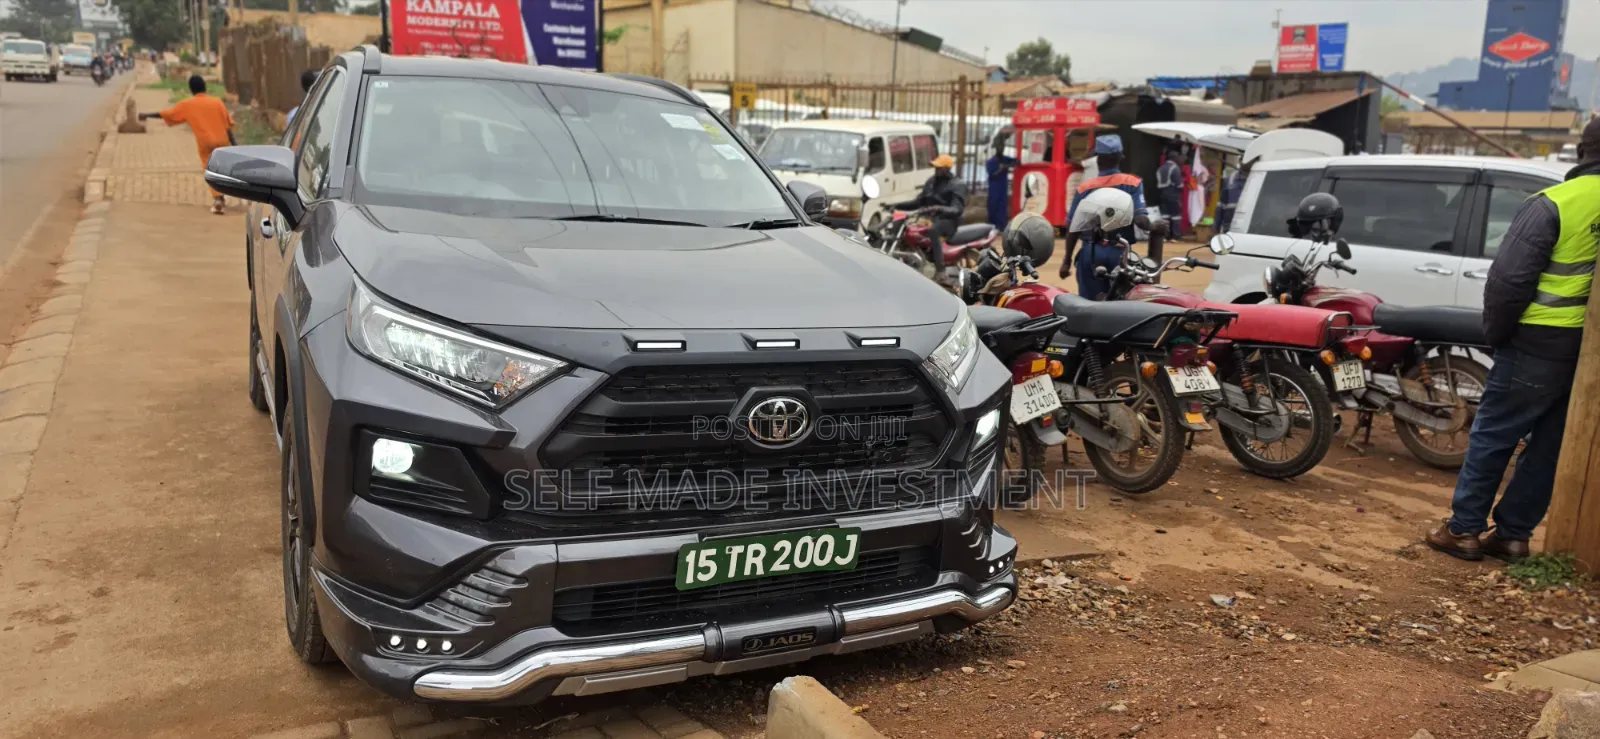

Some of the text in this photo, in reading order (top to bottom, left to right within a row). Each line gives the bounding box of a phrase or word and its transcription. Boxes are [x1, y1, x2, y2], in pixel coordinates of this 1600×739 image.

[406, 0, 501, 18] KAMPALA
[741, 95, 749, 108] 5
[1023, 380, 1045, 398] UMA
[685, 549, 717, 584] 15
[763, 632, 813, 648] JAOS
